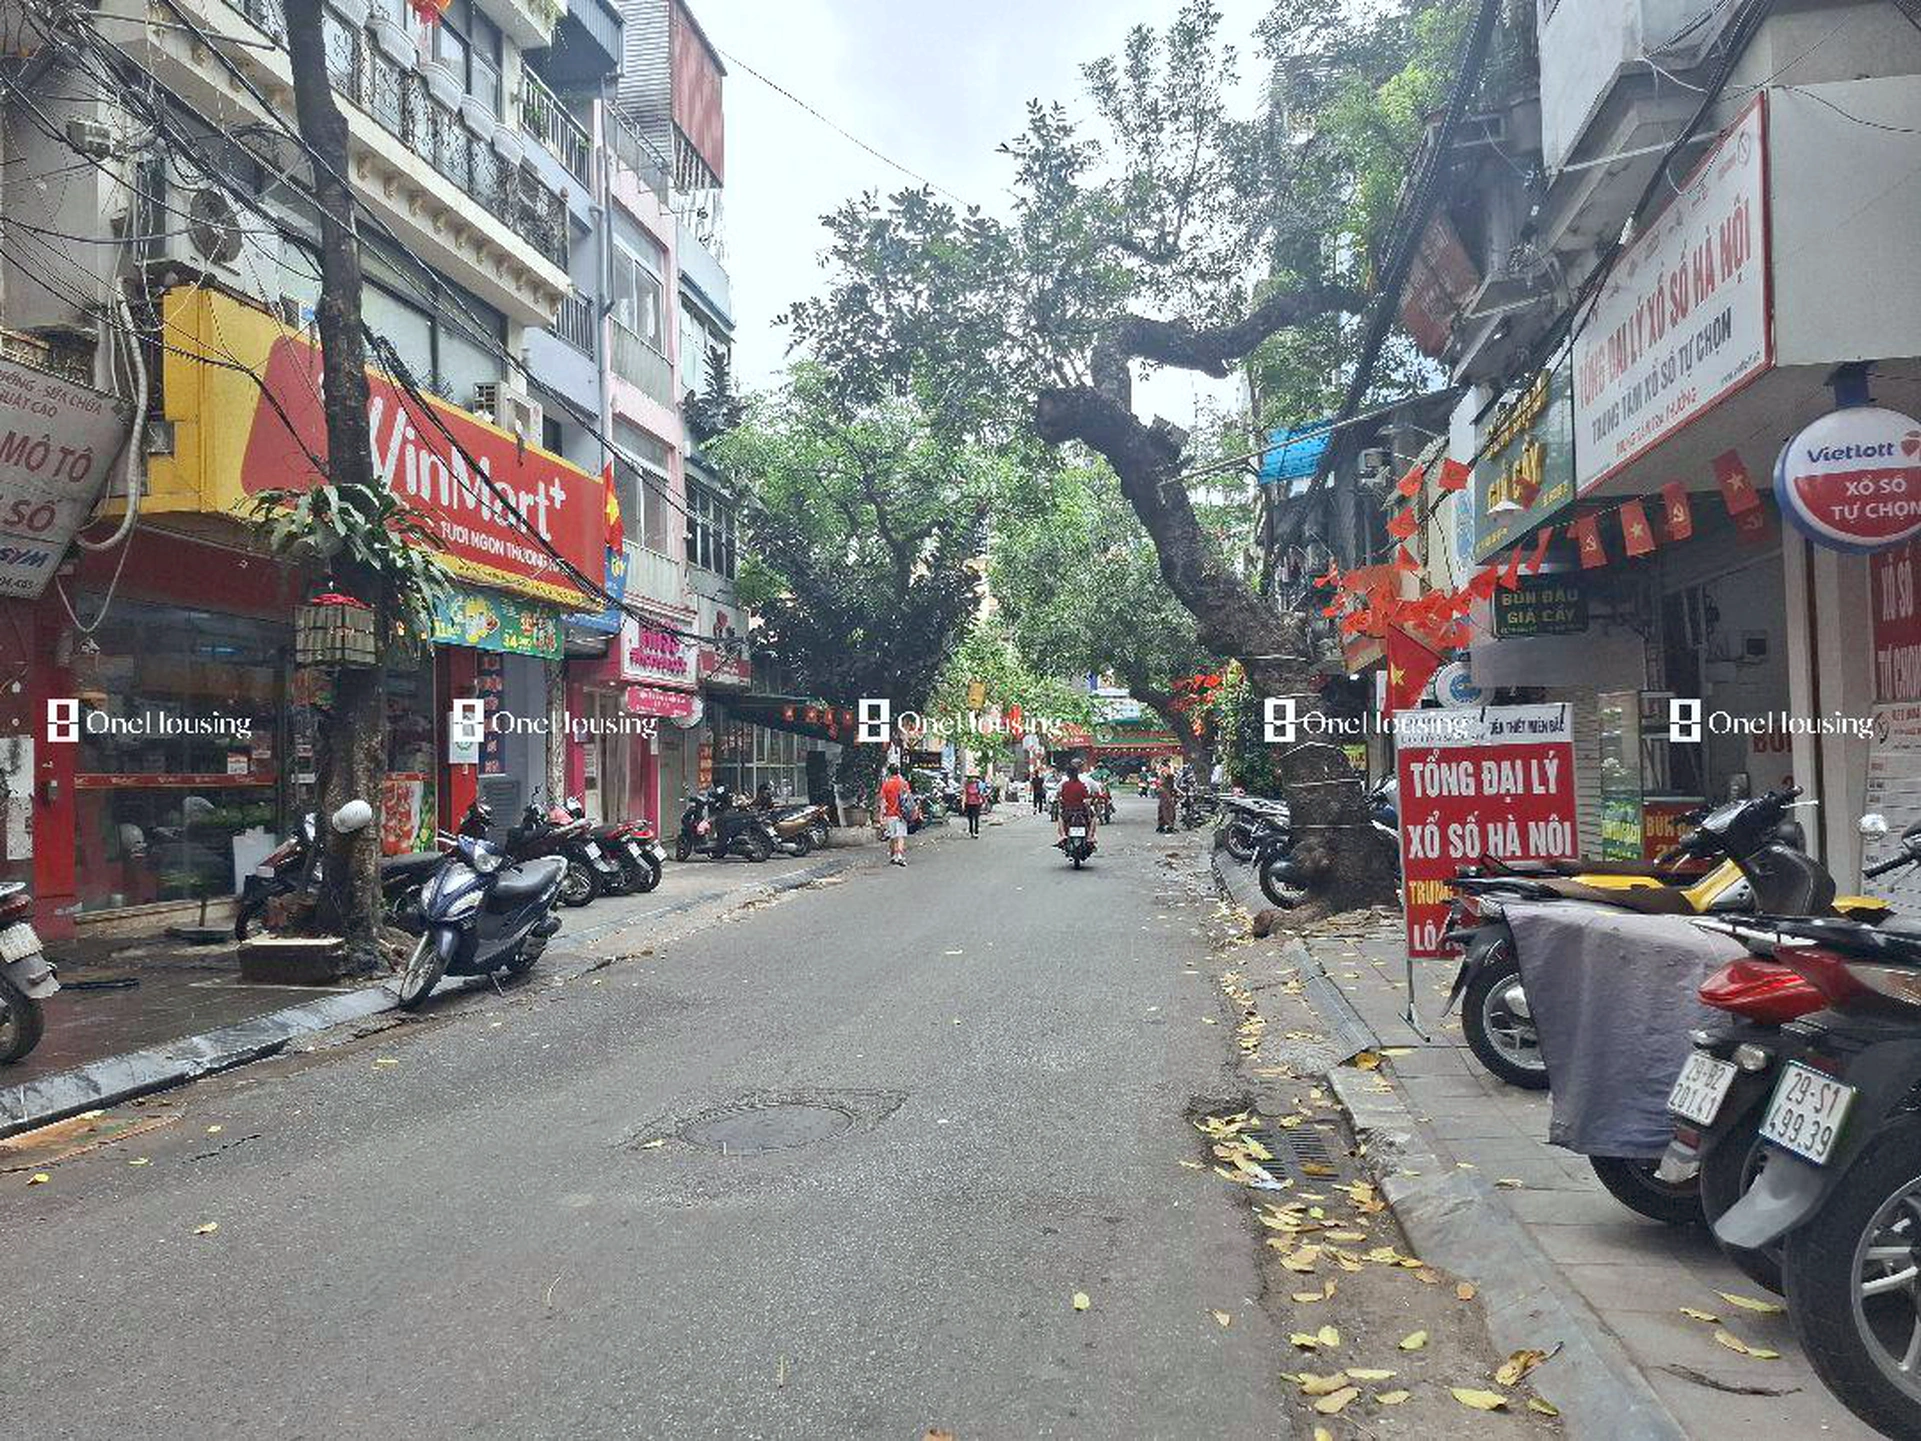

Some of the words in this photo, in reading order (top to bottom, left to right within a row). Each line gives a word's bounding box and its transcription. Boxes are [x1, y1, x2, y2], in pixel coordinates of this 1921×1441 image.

[1693, 226, 1715, 308] HÀ
[1696, 306, 1732, 363] CHỌN
[31, 401, 58, 418] CAO
[1, 430, 50, 473] MÔ
[53, 445, 93, 484] TÔ
[1807, 442, 1894, 463] Vietlott
[1845, 474, 1875, 496] XỔ
[1830, 501, 1860, 524] TỰ
[1865, 501, 1921, 520] CHỌN
[1410, 749, 1475, 797] TỔNG
[1481, 759, 1524, 803] ĐẠI
[1531, 750, 1559, 795] LÝ
[1407, 810, 1440, 859] XỔ
[1448, 811, 1481, 858] SỐ
[1486, 814, 1521, 857] HÀ
